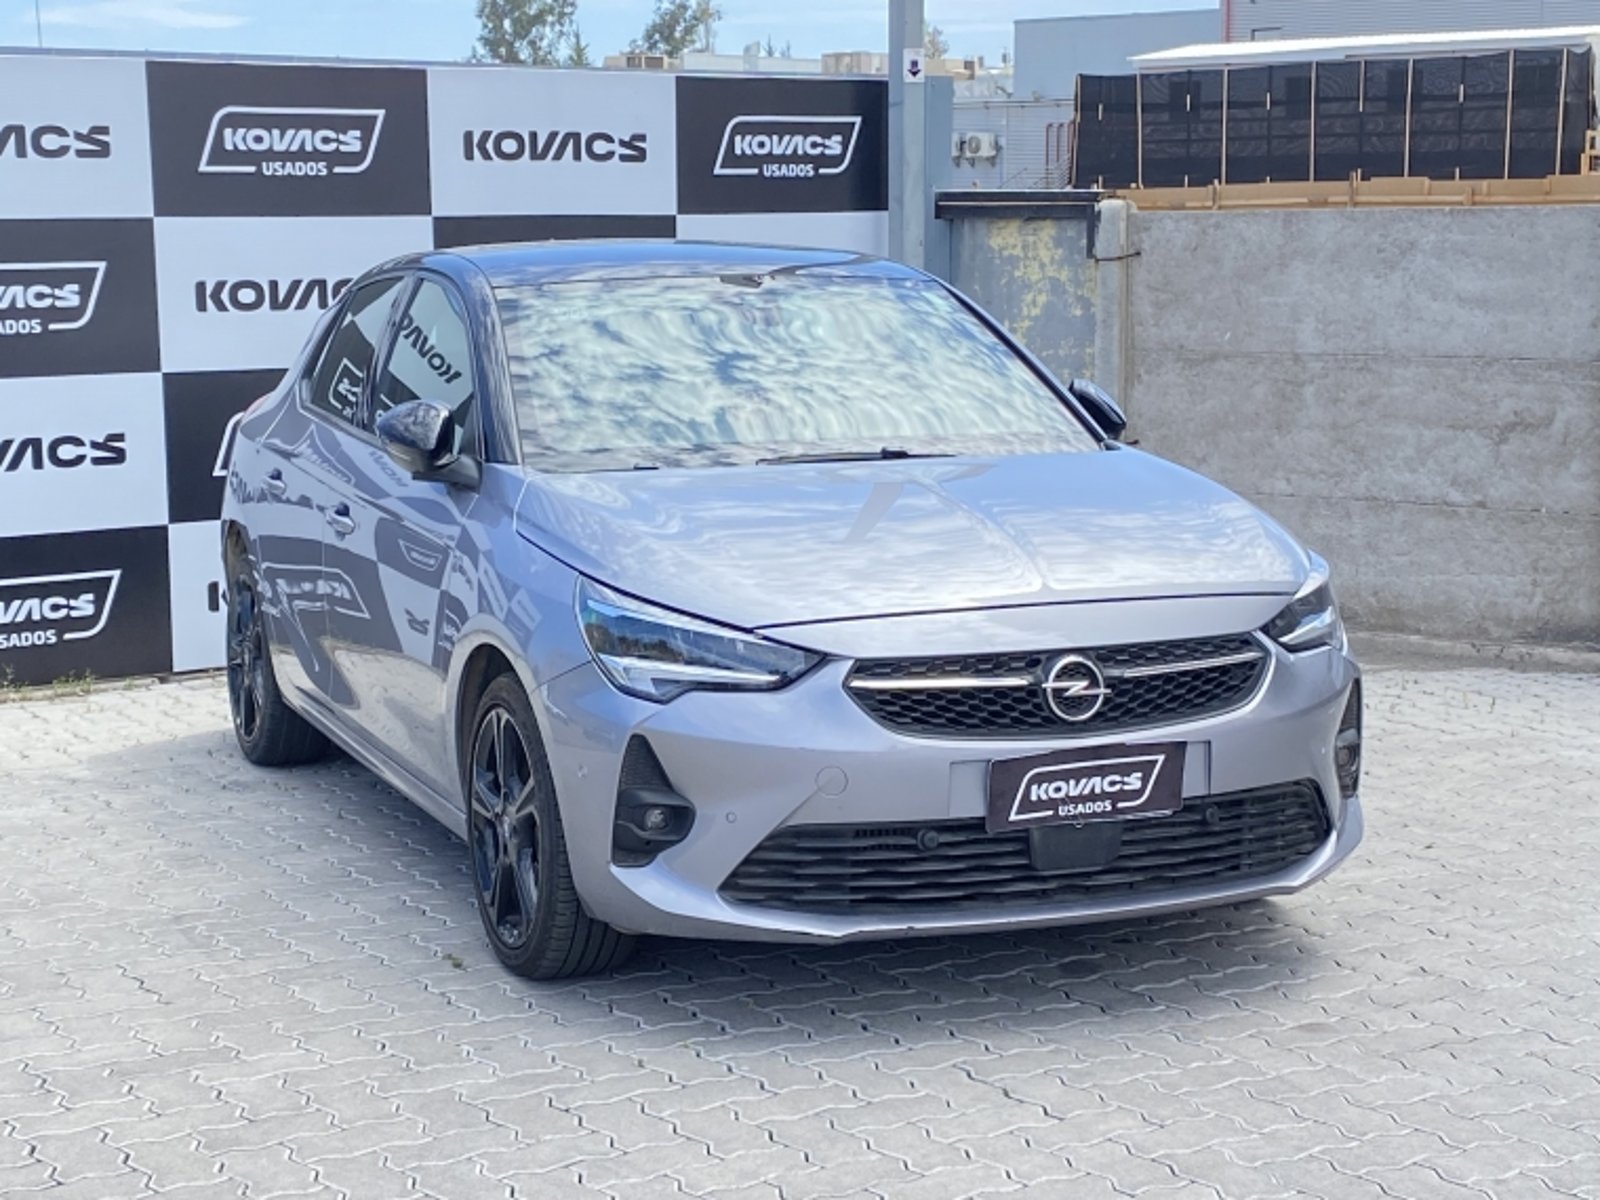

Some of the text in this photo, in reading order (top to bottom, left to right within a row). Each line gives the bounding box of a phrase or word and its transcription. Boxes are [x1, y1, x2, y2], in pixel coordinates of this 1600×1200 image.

[223, 128, 361, 152] KOVACS
[463, 130, 647, 162] KOVACS
[734, 134, 843, 155] KOVACS
[261, 161, 327, 176] USADOS
[763, 164, 815, 177] USADOS
[1030, 772, 1142, 801] KOVACS
[1058, 799, 1112, 815] USADOS
